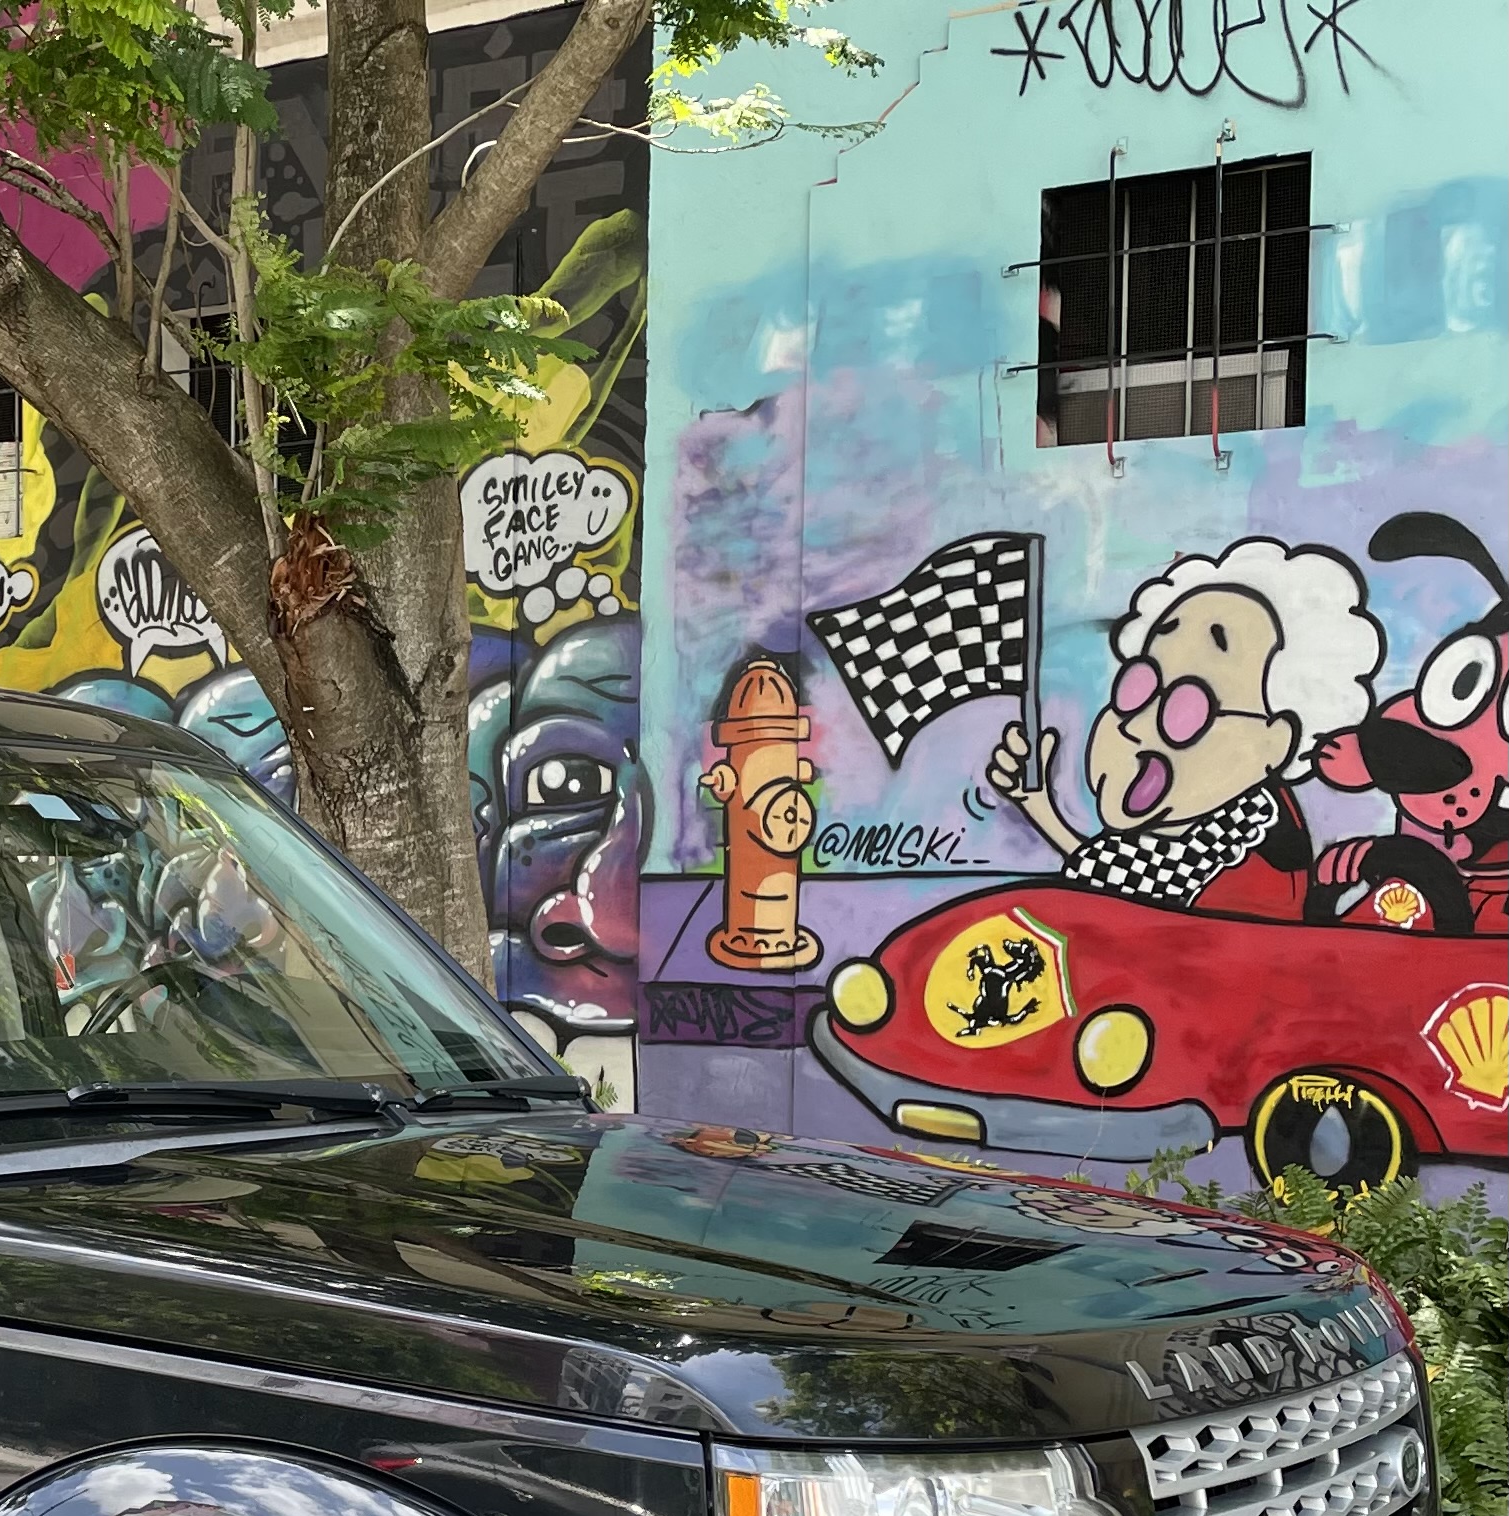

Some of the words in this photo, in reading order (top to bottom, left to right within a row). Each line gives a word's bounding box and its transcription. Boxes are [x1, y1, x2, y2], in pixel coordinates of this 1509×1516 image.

[482, 471, 585, 505] SMILEY
[483, 503, 560, 550] FACE
[1124, 1334, 1285, 1400] LAND
